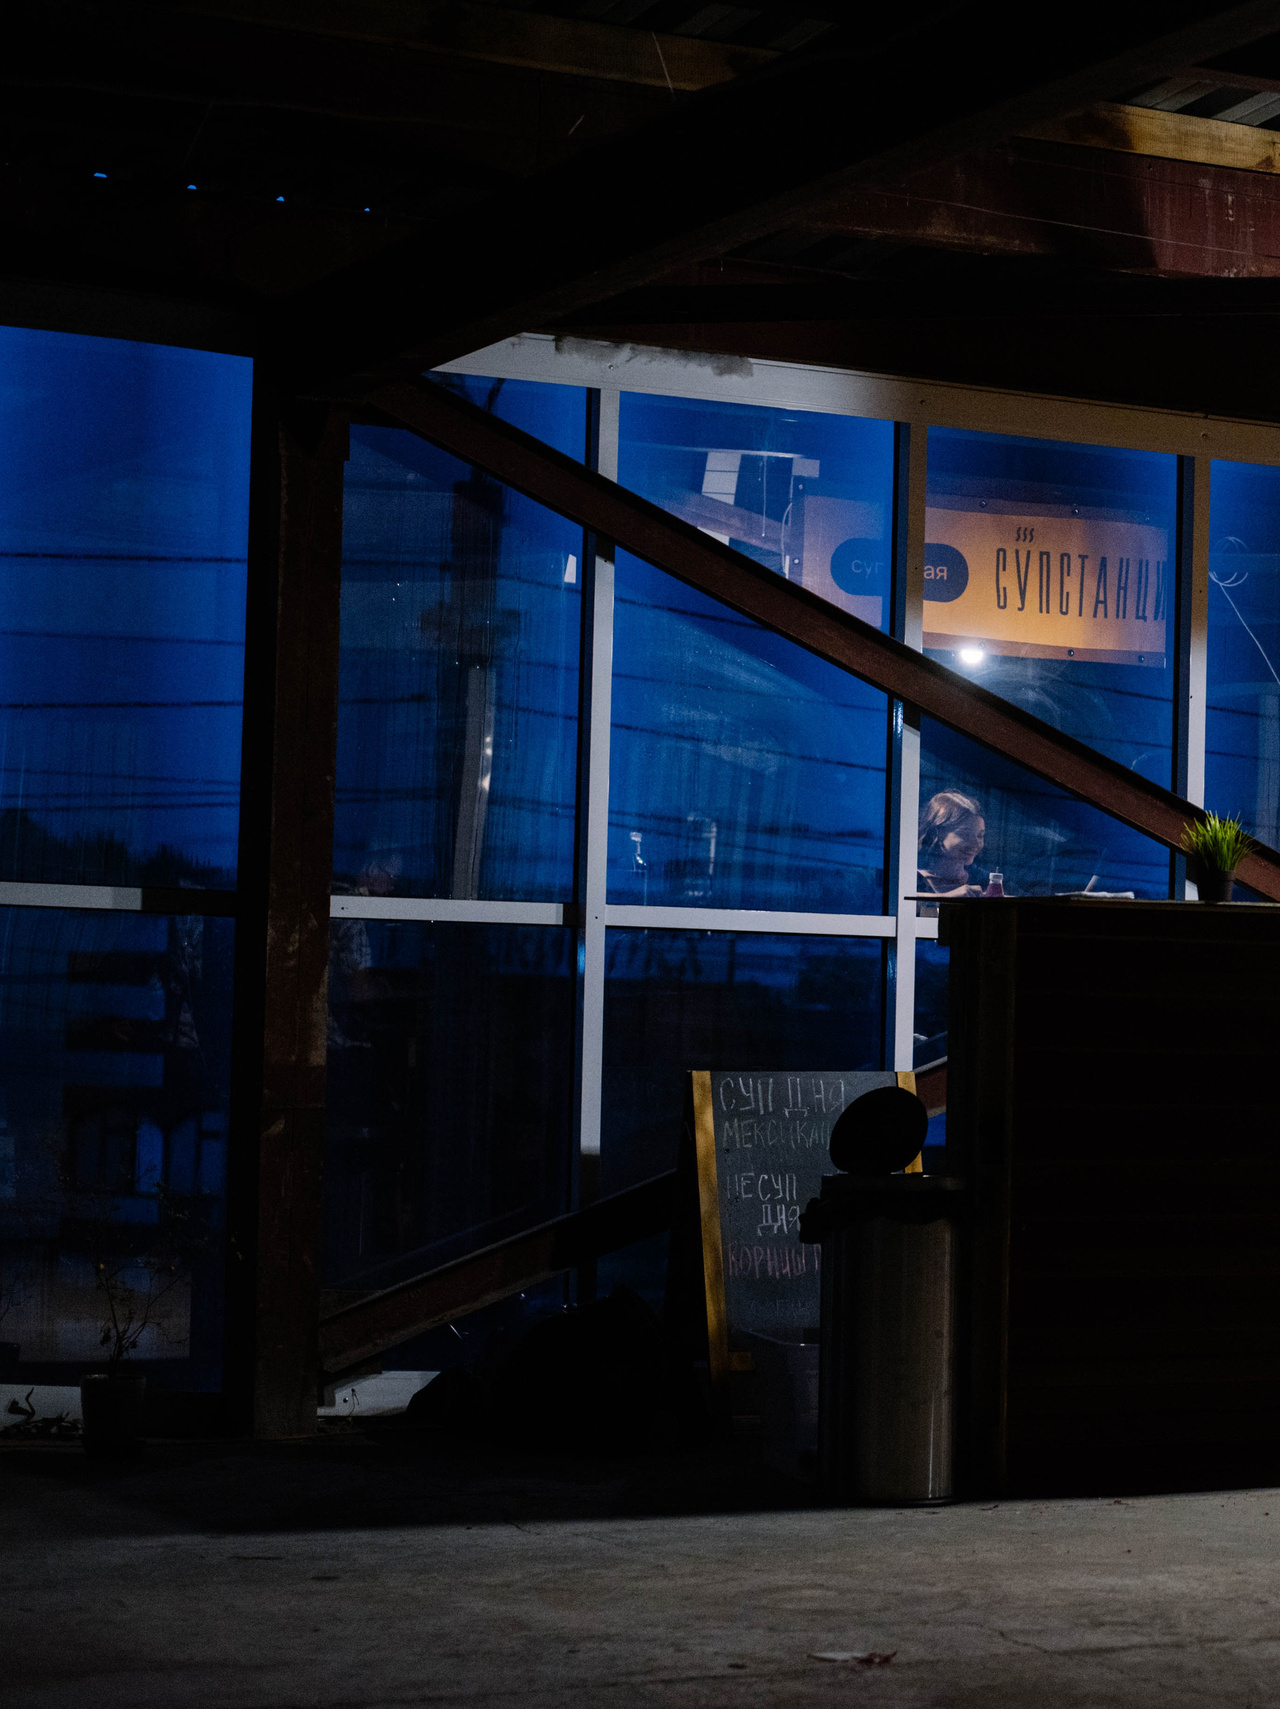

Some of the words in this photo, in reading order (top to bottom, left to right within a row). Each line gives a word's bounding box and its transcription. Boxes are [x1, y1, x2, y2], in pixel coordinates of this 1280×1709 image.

[720, 1077, 774, 1116] СУП
[783, 1076, 845, 1119] ДНЯ
[757, 1203, 800, 1237] ДНЯ
